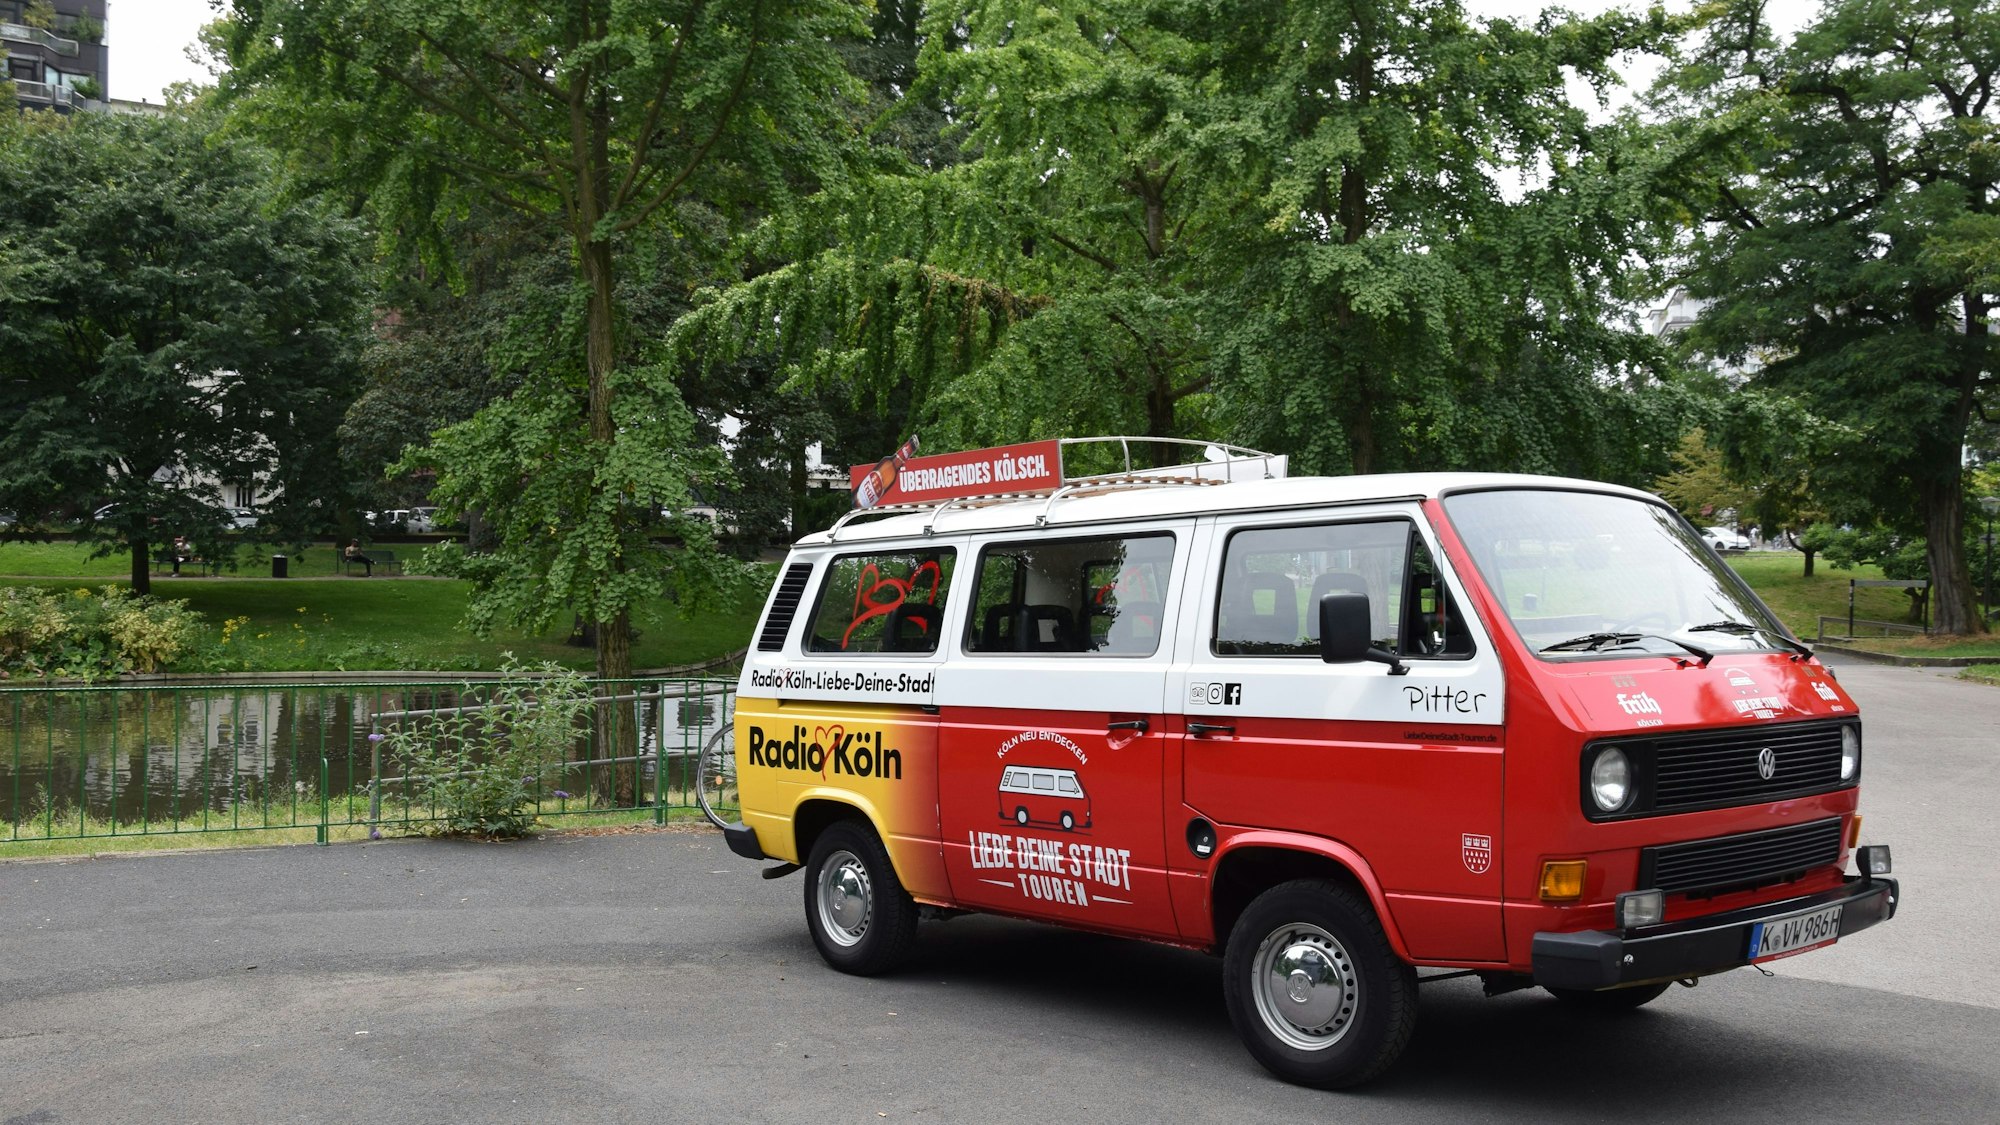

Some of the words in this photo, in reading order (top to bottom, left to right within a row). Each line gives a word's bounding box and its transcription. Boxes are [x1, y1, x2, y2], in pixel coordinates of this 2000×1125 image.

[899, 461, 991, 493] ÜBERRAGENDES
[994, 453, 1050, 482] KÖLSCH.
[751, 669, 783, 688] Radio
[1403, 685, 1487, 713] Pitter
[1636, 719, 1664, 727] KÖLSCH
[750, 725, 824, 772] Radio
[834, 732, 902, 780] Köln
[997, 736, 1019, 759] KÖLN
[1019, 731, 1037, 743] NEU
[1039, 730, 1088, 765] ENTDECKEN
[969, 830, 1015, 869] LIEBE
[1016, 836, 1066, 874] DEINE
[1068, 843, 1131, 891] STADT
[1018, 873, 1089, 907] TOUREN
[1760, 926, 1775, 953] K
[1783, 919, 1805, 948] VW
[1804, 908, 1841, 942] 986H
